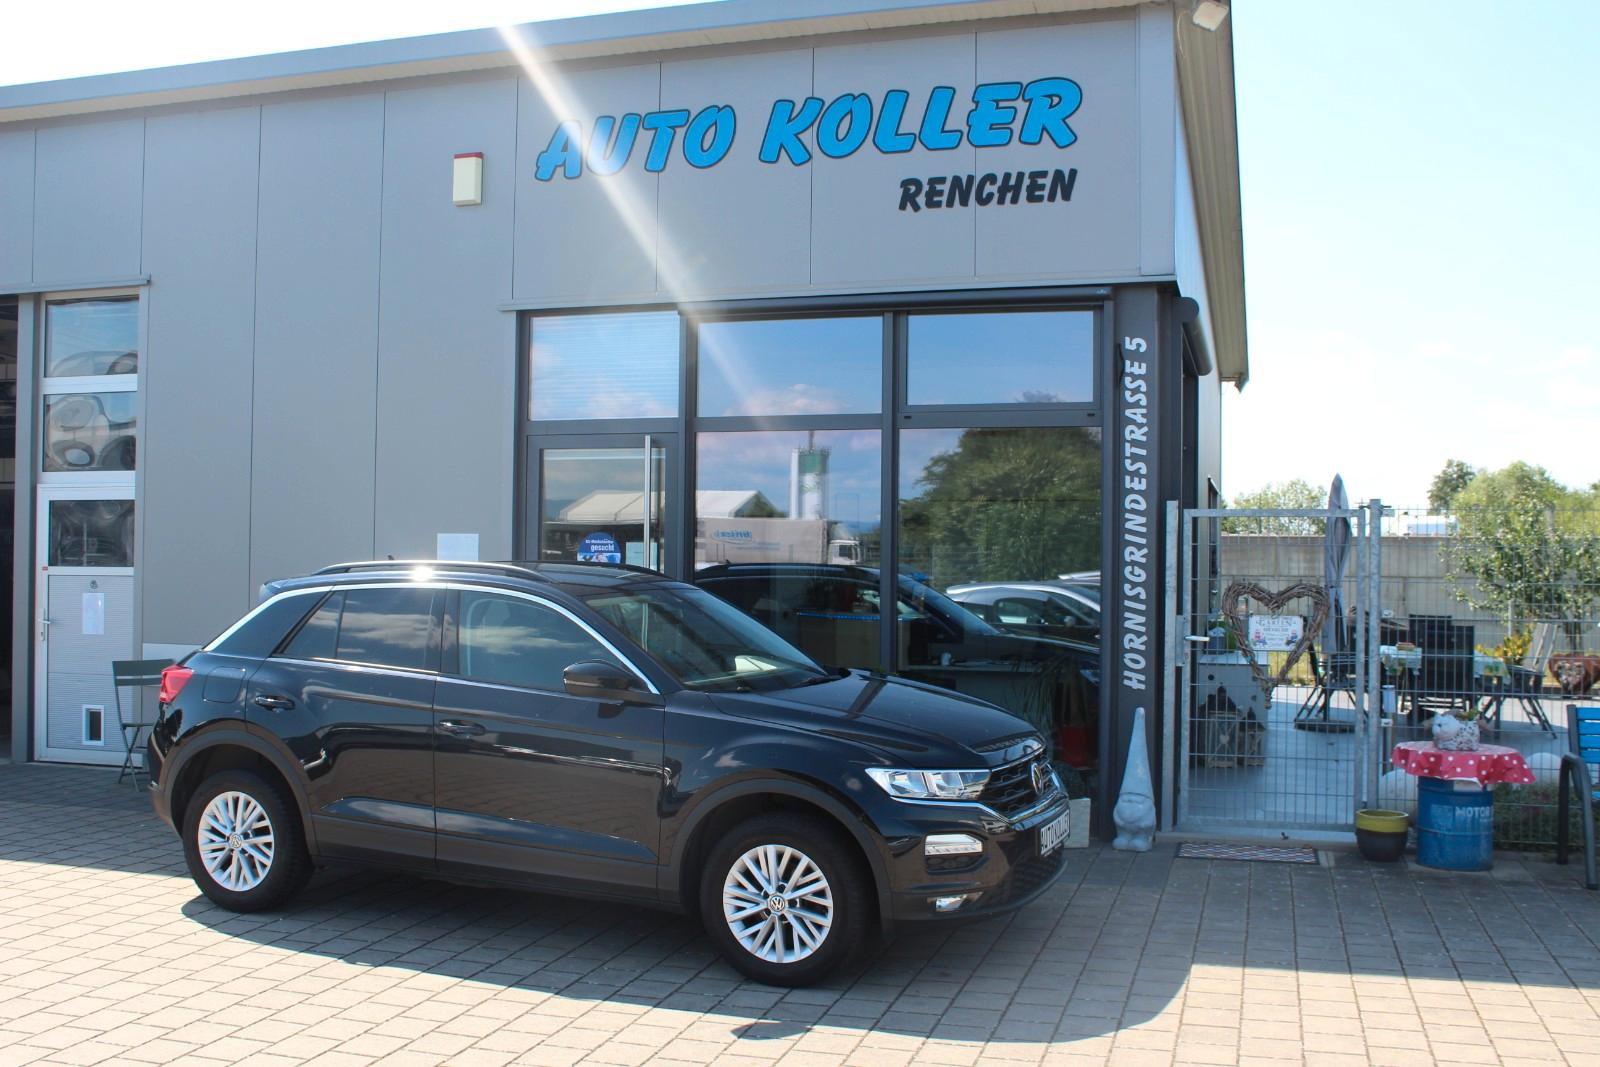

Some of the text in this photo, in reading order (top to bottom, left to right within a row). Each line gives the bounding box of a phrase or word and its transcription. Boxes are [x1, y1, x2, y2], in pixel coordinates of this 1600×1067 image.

[535, 77, 1083, 181] AUTO KOLLER
[899, 168, 1078, 212] RENCHEN
[1122, 336, 1148, 690] HORNISGRINDESTRASSE 5
